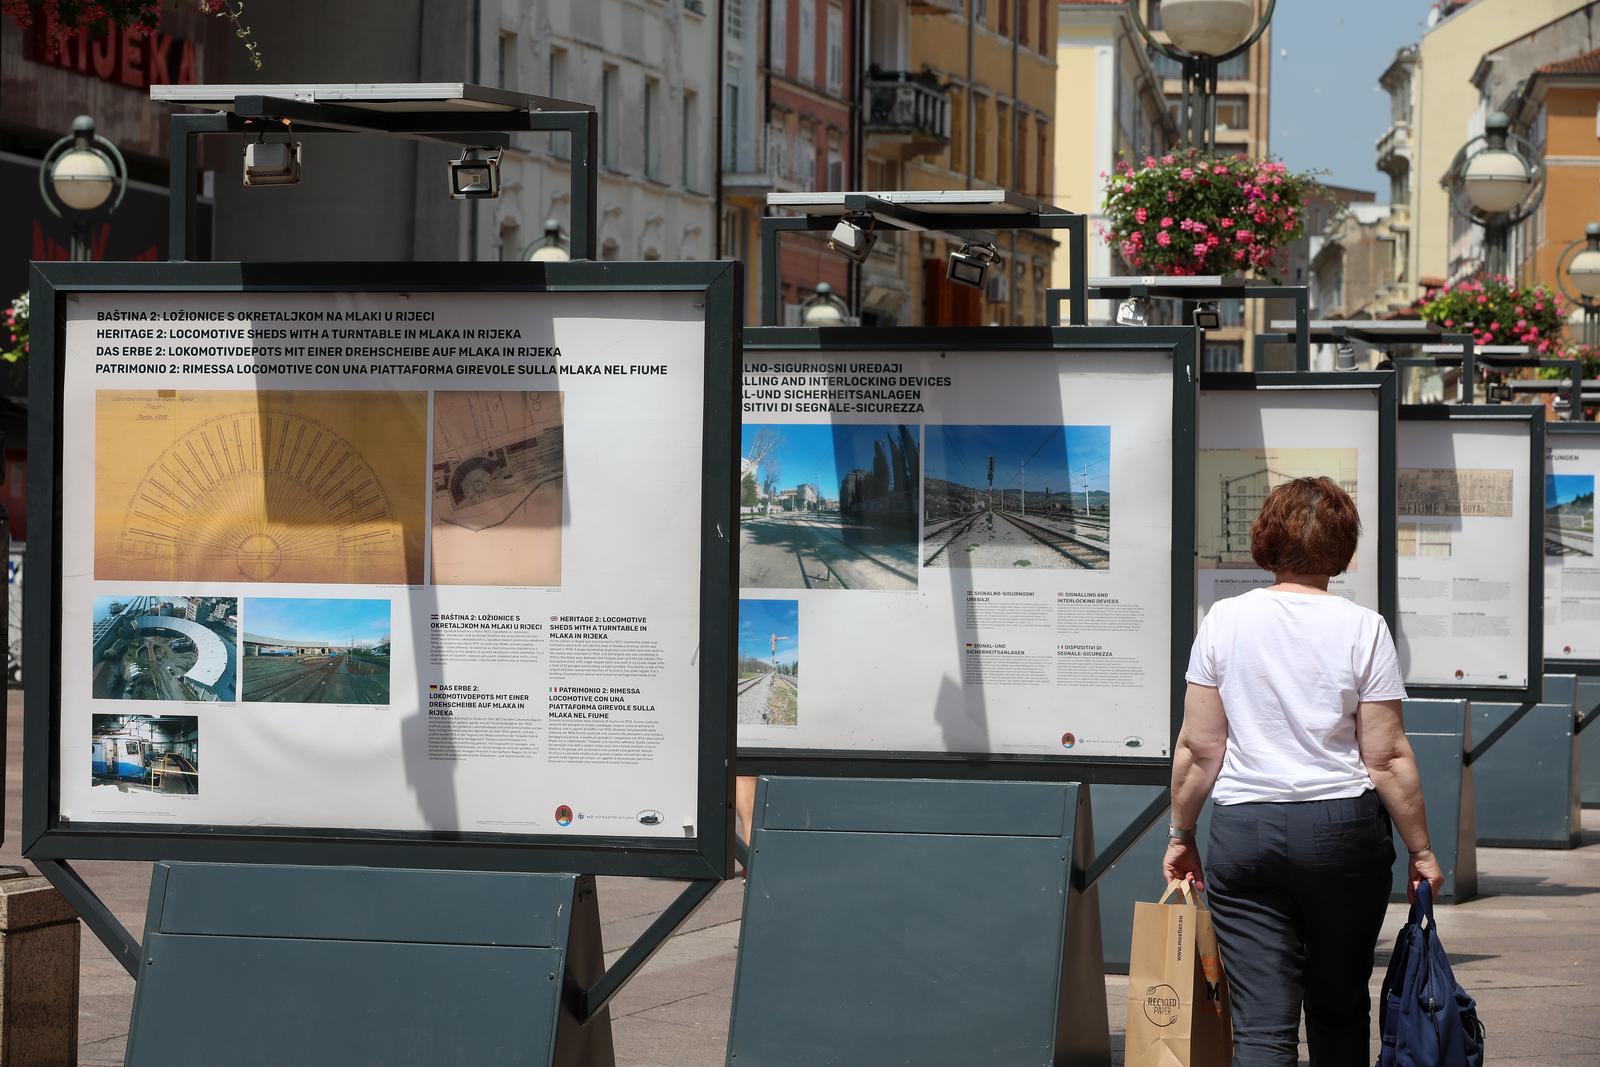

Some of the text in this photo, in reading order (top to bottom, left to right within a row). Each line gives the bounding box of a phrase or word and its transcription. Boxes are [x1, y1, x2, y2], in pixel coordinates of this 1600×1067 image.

[97, 309, 434, 321] BAŠTINA 2: LOŽIONICE S OKRETALJKOM NA MLAKI U RIJECI
[97, 329, 521, 339] HERITAGE 2: LOCOMOTIVE SHEDS WITH A TURNTABLE IN MLAKA IN RIJEKA
[96, 347, 561, 356] DAS ERBE 2: LOKOMOTIVDEPOTS MIT EINER DREHSCHEIBE AUF MLAKA IN RIJEKA
[96, 364, 667, 374] PATRIMONIO 2: RIMESSA LOCOMOTIVE CON UNA PIATTAFORMA GIREVOLE SULLA MLAKA NEL FIUME
[742, 364, 902, 373] LNO-SIGURNOSNI UREĐAJI
[742, 377, 952, 386] LLING AND INTERLOCKING DEVICES
[742, 390, 920, 400] L-UND SICHERHEITSANLAGEN
[742, 403, 924, 412] SITIVI DI SEGNALE-SICUREZZA
[1148, 997, 1176, 1007] RECYCLED
[1154, 1006, 1172, 1015] PAPER
